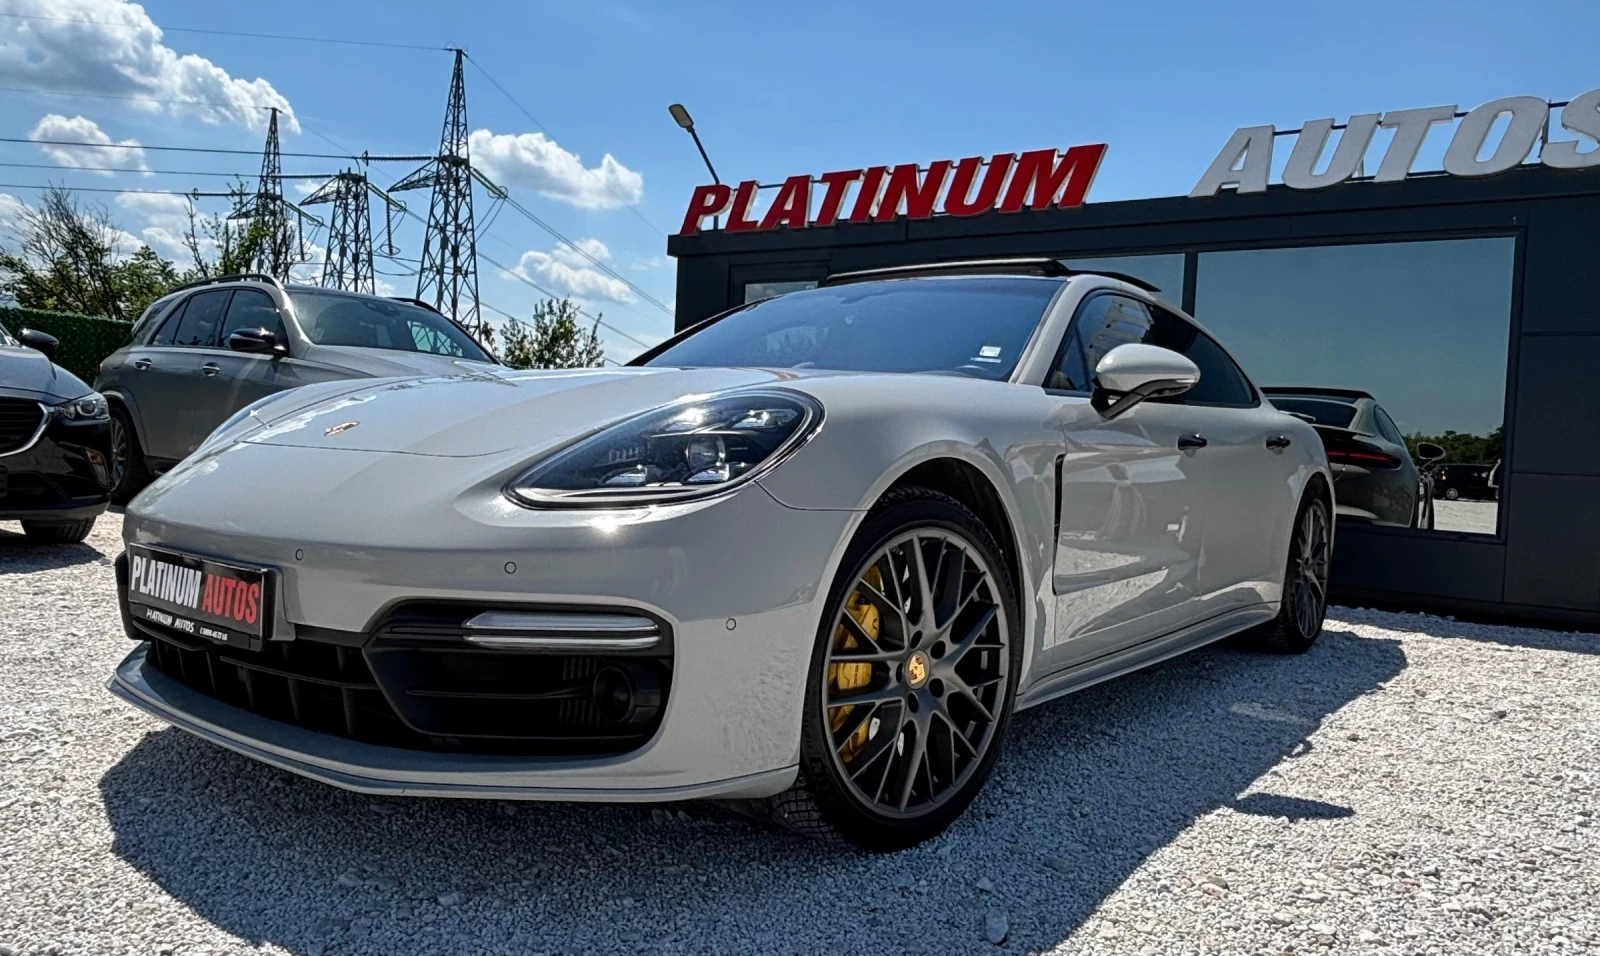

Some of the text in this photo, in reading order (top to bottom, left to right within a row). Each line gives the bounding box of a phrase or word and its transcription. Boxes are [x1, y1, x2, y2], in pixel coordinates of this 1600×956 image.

[679, 143, 1109, 236] PLATINUM
[131, 556, 260, 624] PLATINUM AUTOS
[174, 618, 195, 633] AUTOS
